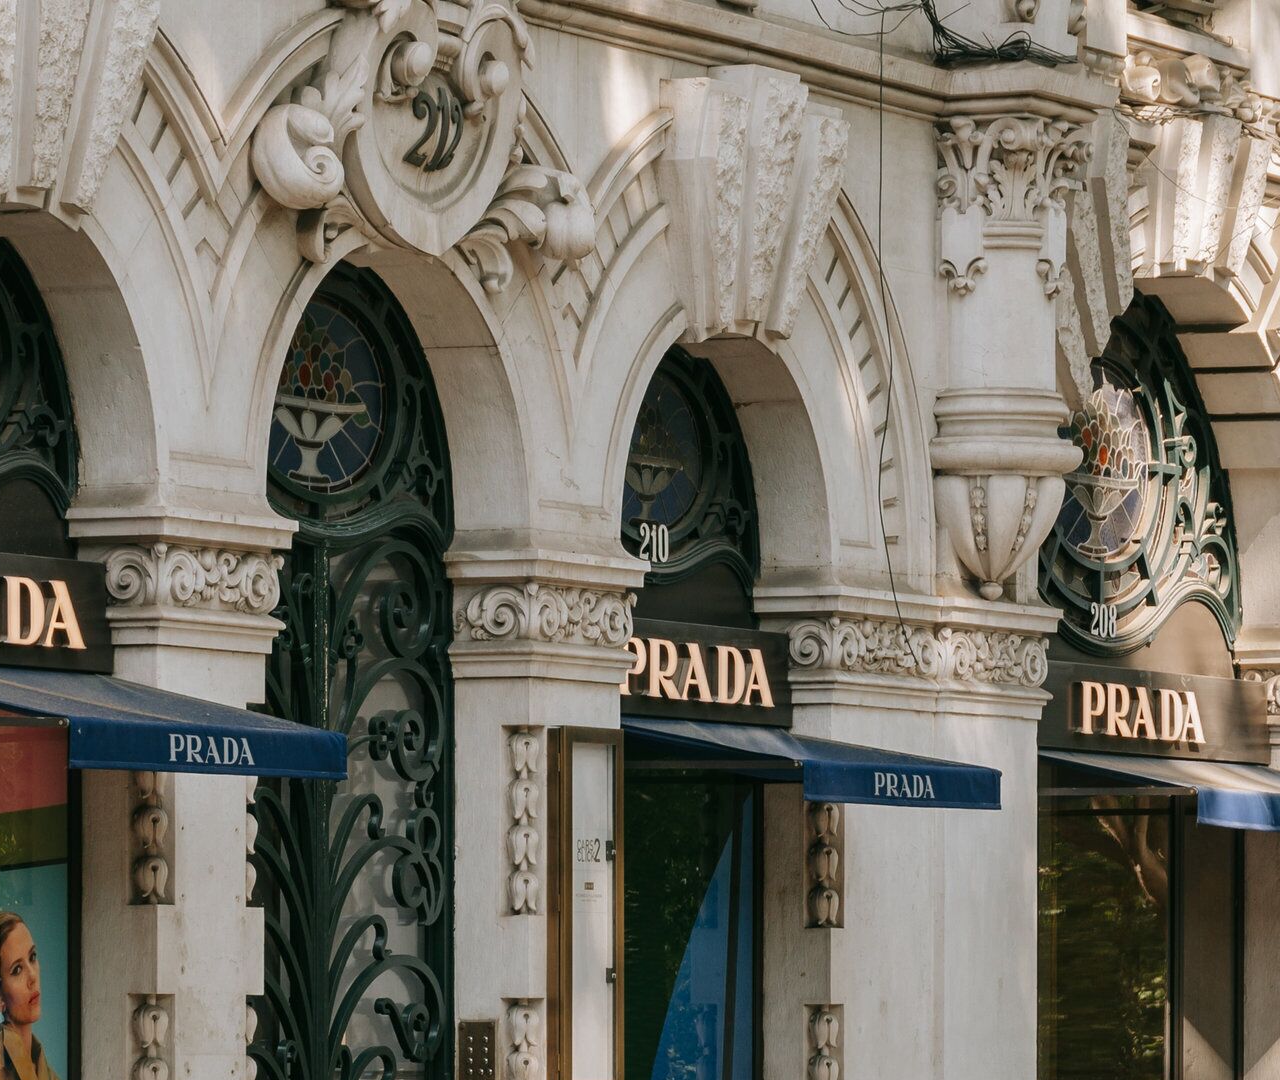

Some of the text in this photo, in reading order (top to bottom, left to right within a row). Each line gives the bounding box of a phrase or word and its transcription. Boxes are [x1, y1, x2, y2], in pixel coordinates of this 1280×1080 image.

[638, 523, 670, 564] 210
[1090, 602, 1118, 639] 208
[621, 637, 775, 708] PRADA
[1081, 680, 1206, 745] PRADA
[169, 733, 256, 766] PRADA
[874, 771, 936, 799] PRADA
